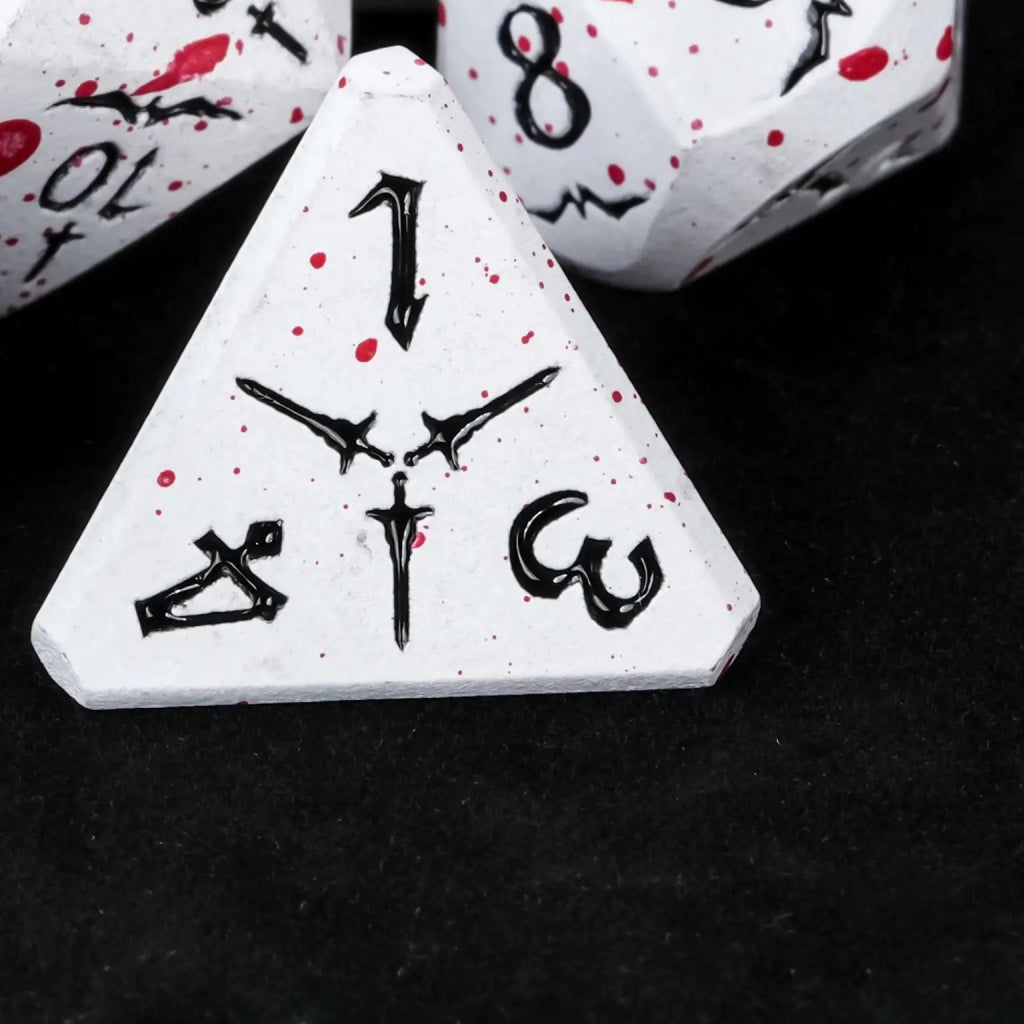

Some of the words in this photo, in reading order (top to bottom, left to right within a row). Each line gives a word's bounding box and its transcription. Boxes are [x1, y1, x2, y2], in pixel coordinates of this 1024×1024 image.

[497, 3, 592, 150] 8
[38, 140, 160, 220] 10
[348, 170, 430, 352] 1
[133, 518, 289, 638] 4
[508, 489, 665, 631] 3
